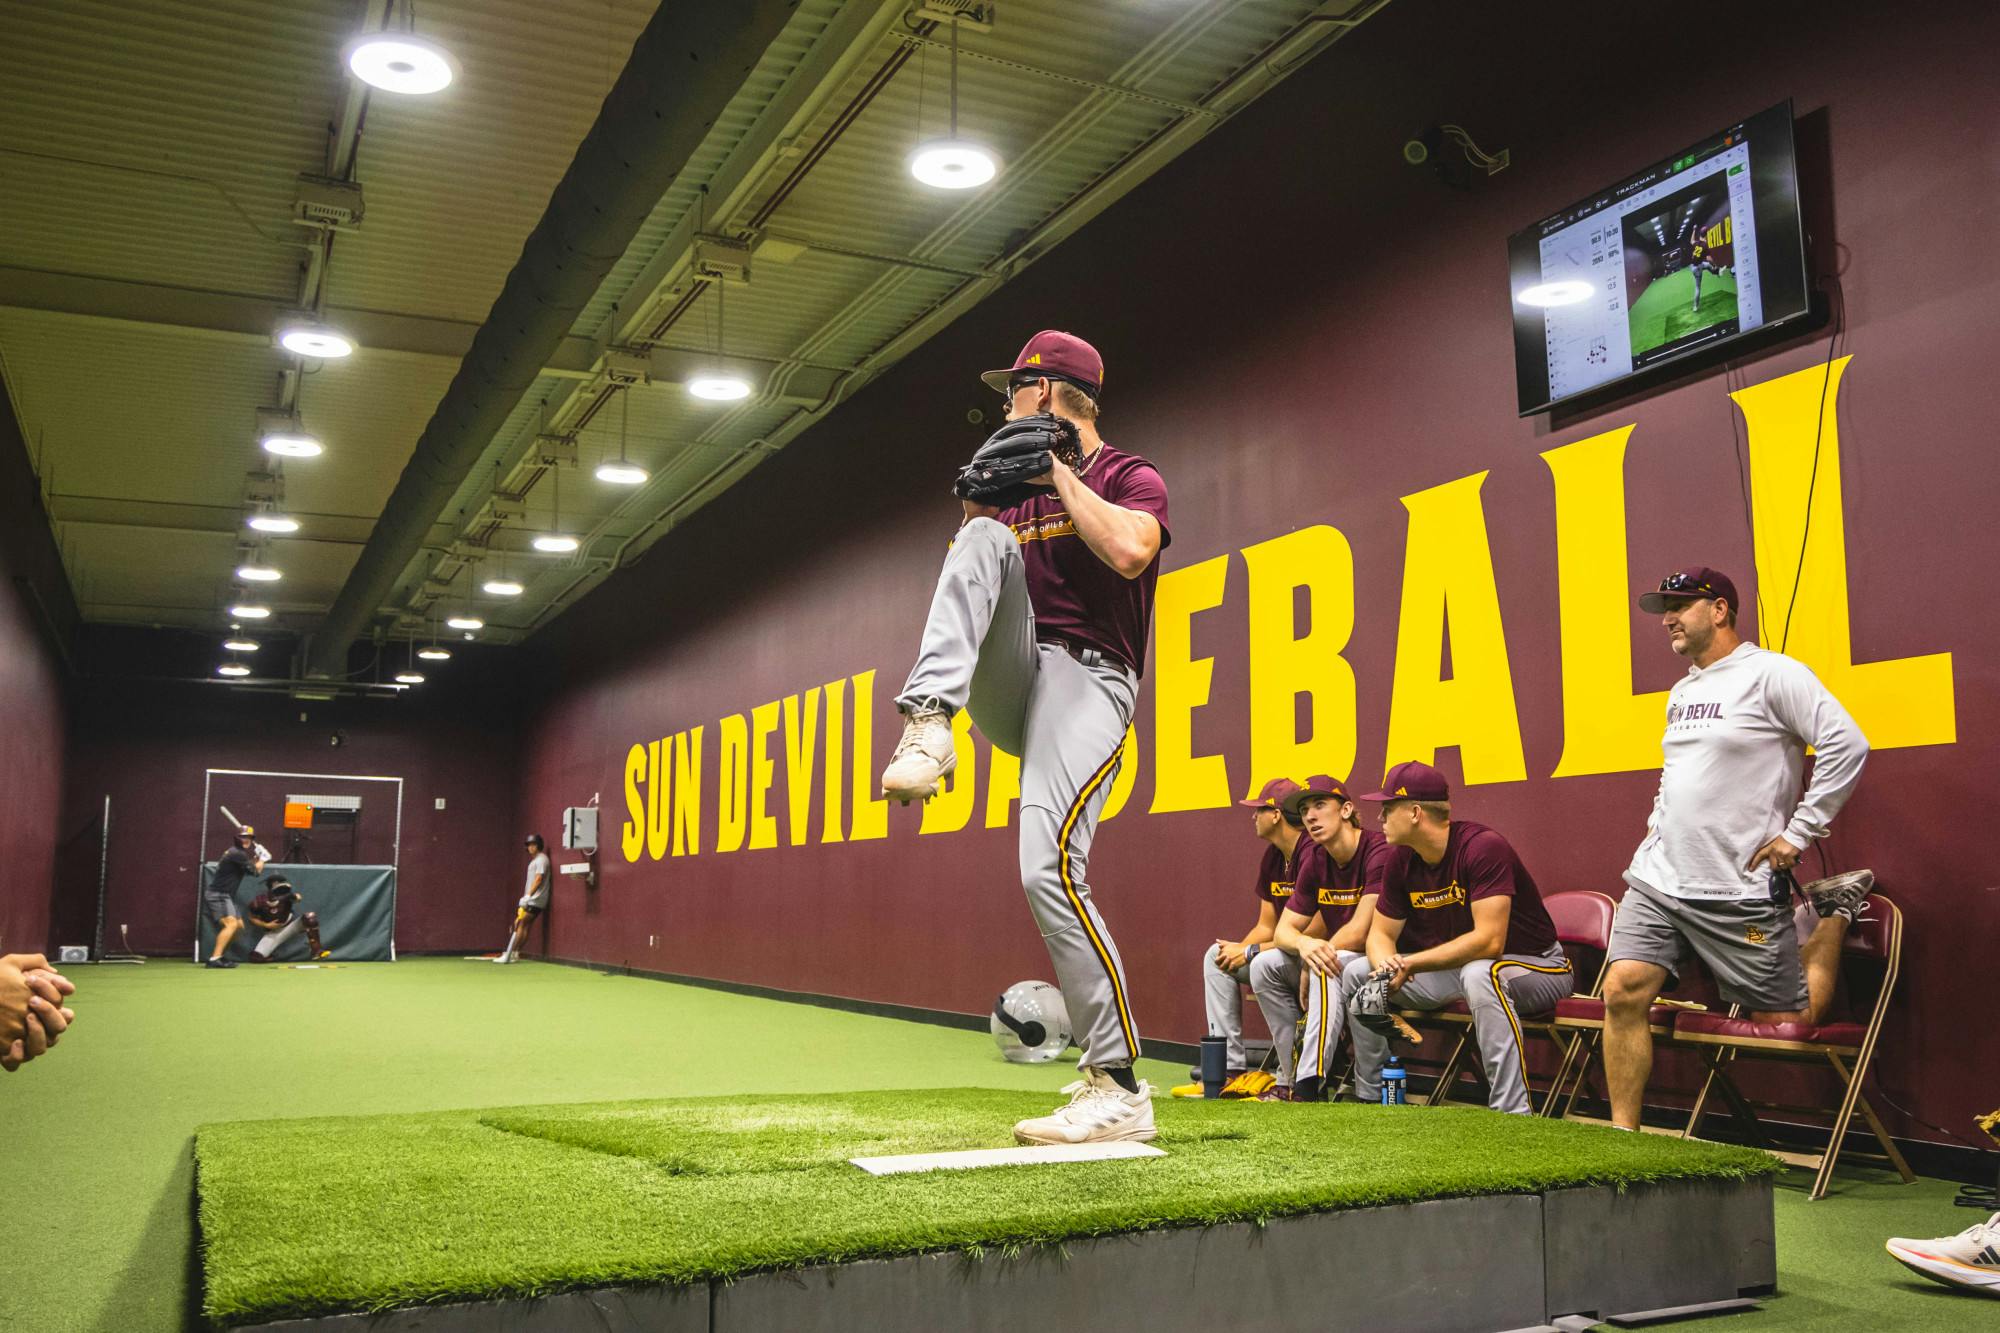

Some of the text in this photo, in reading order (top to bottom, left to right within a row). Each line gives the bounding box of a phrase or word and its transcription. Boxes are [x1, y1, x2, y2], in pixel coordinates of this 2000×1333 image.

[1616, 174, 1656, 196] TRACKMAN
[622, 354, 1957, 863] SUN DEVIL BEBALL
[1684, 702, 1724, 721] DEVIL
